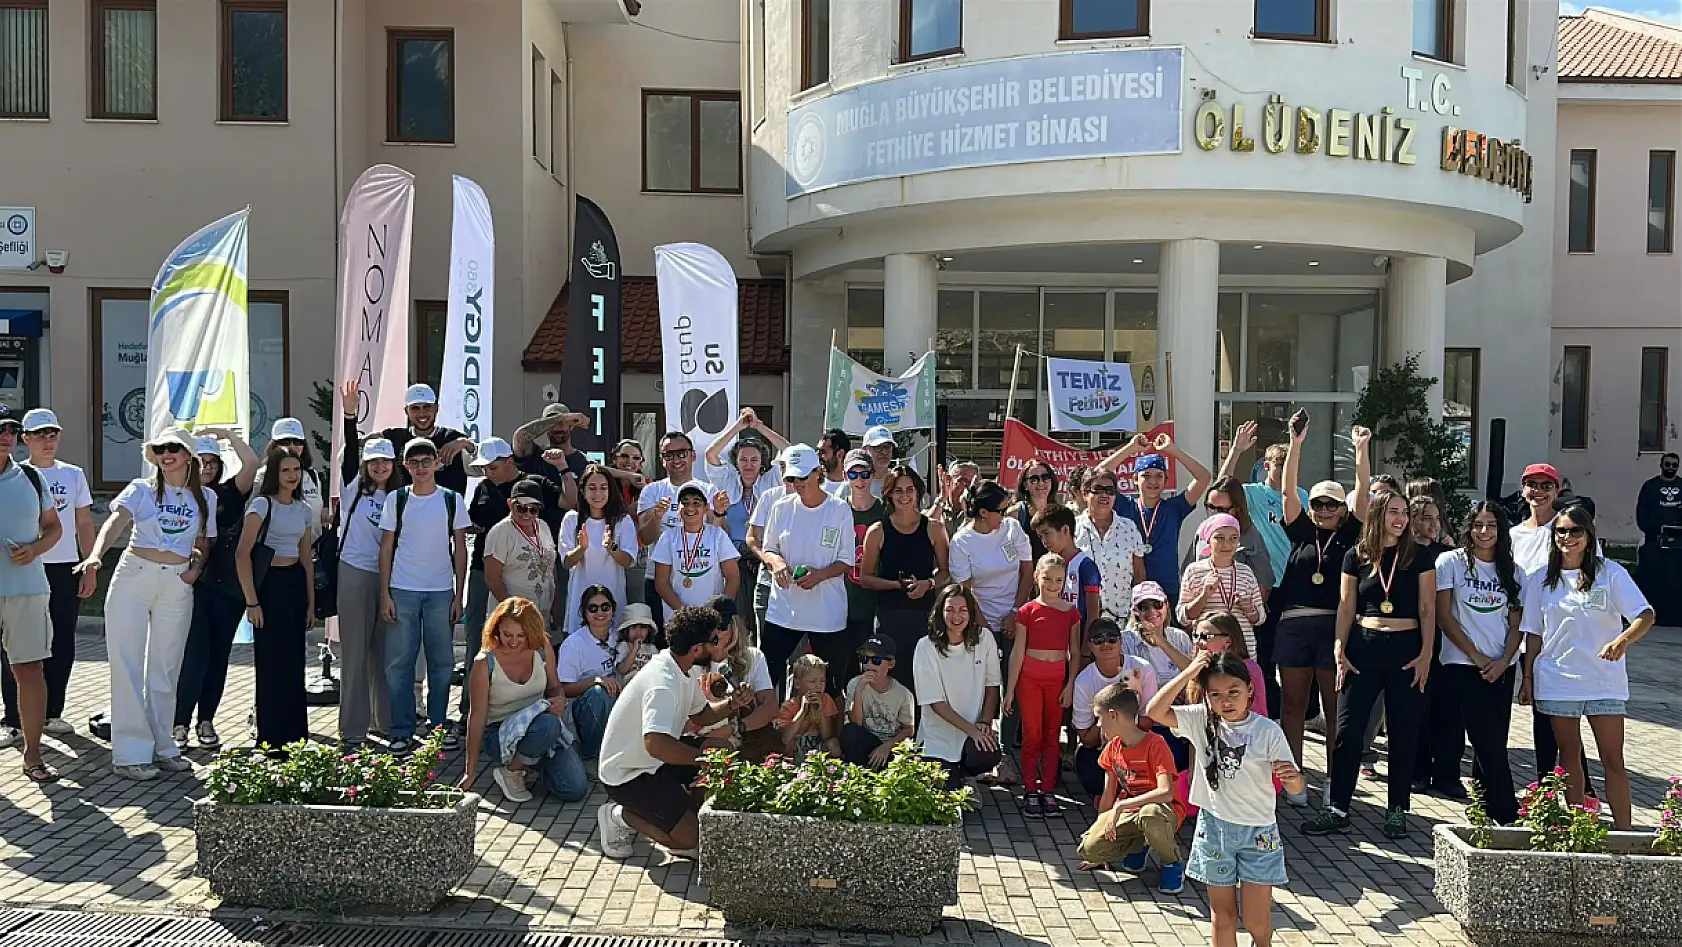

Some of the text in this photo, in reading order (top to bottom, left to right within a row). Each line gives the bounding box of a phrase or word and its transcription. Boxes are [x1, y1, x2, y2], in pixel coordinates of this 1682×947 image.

[836, 66, 1164, 136] MUĞLA BÜYÜKŞEHİR BELEDİYESİ
[1400, 66, 1461, 117] T.C.
[867, 114, 1108, 167] FETHİYE HİZMET BİNASI
[1194, 87, 1418, 166] ÖLÜDENİZ
[356, 222, 388, 436] NOMAD
[1056, 365, 1122, 391] TEMİZ
